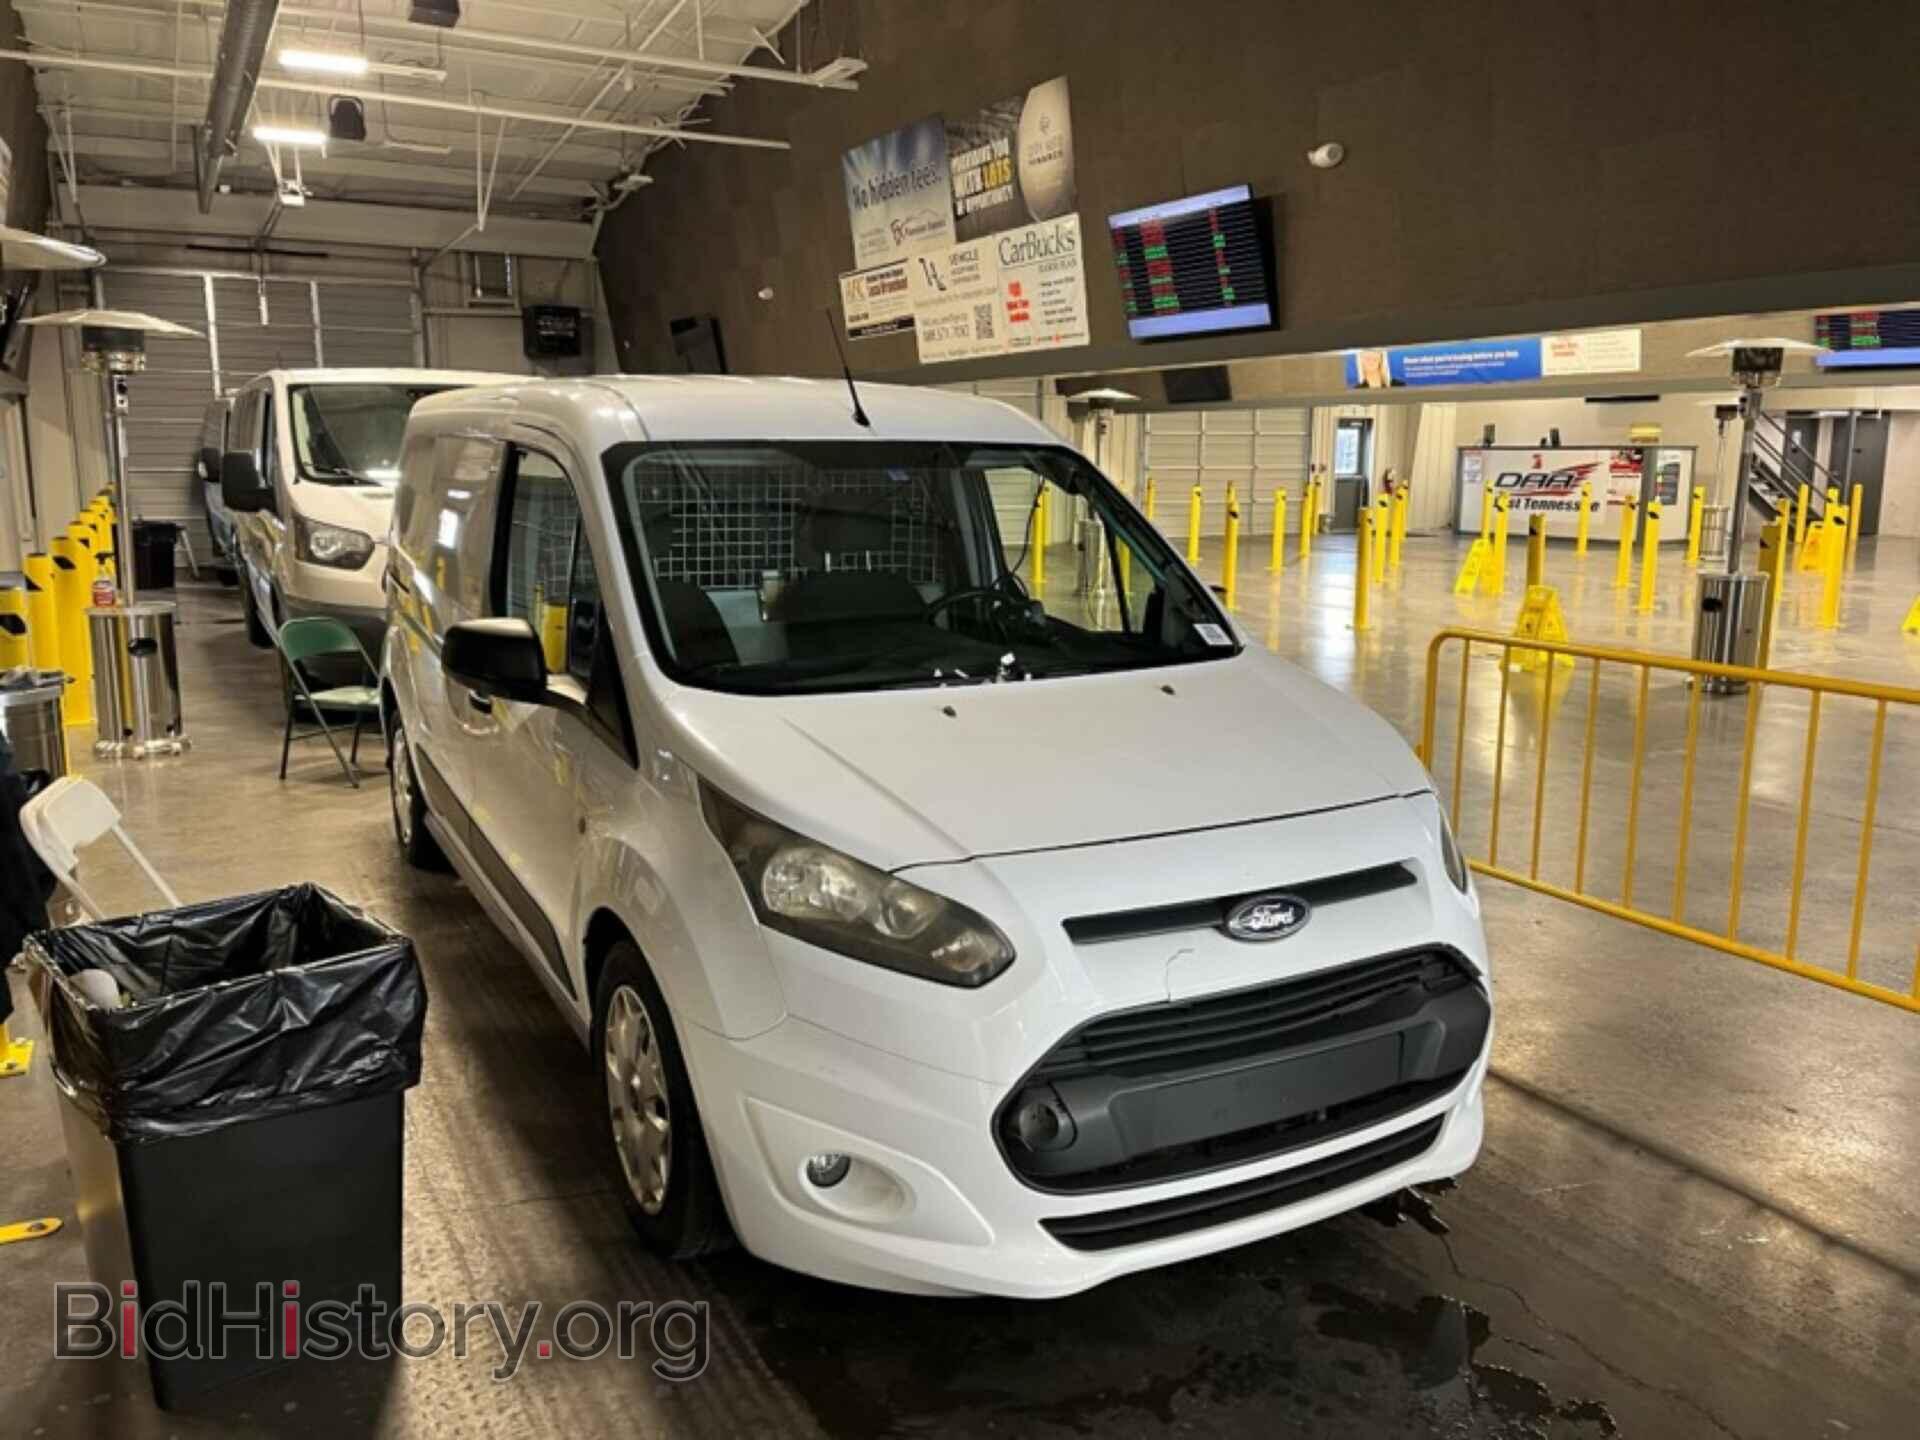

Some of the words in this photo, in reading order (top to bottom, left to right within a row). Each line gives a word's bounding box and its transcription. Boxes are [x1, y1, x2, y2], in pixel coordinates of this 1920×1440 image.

[851, 184, 868, 210] No
[868, 171, 910, 206] hidden
[998, 223, 1077, 266] CarBucks
[1494, 472, 1574, 489] DAA
[1523, 498, 1600, 513] Tennesse
[1247, 903, 1295, 931] Ford
